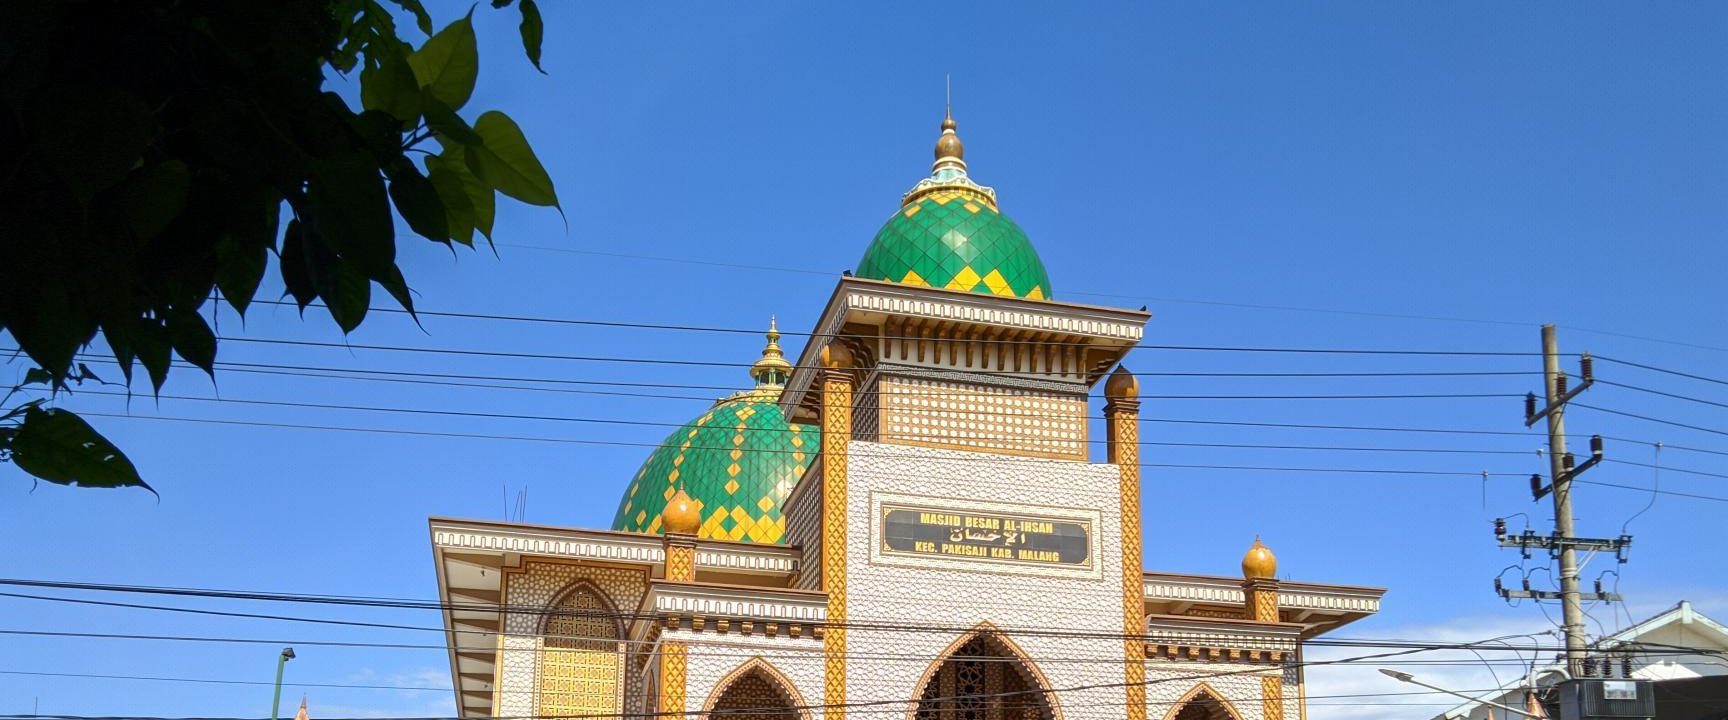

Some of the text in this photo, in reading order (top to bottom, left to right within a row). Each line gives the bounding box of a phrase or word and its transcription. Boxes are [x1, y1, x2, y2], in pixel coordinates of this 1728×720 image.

[920, 512, 1053, 534] MASJID BESAR AL-IHSAN
[915, 541, 1060, 562] KEC. PAKISAJI KAB. MALANG
